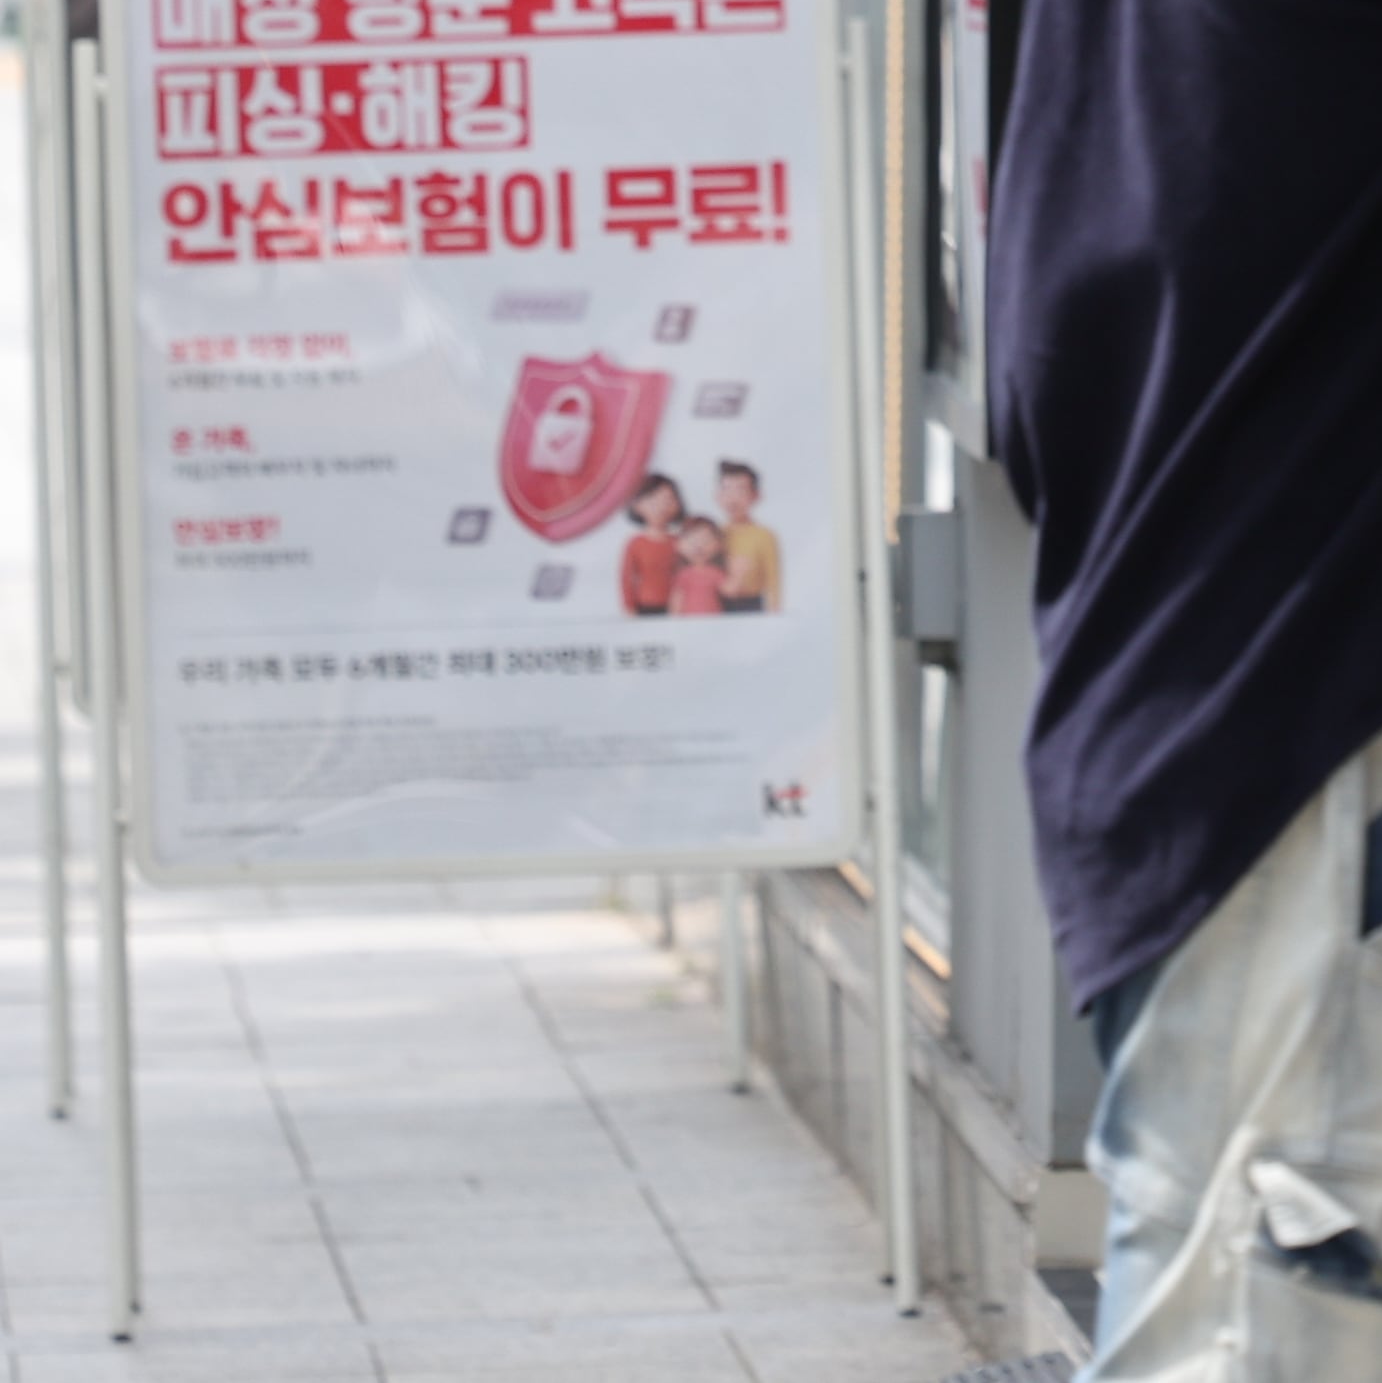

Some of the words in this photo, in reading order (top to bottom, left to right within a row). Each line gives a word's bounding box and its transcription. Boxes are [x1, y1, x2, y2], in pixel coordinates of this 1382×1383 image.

[162, 63, 527, 156] 피싱·해킹
[162, 172, 574, 264] 안심보험이
[604, 161, 790, 251] 무료!
[762, 781, 811, 817] kt
